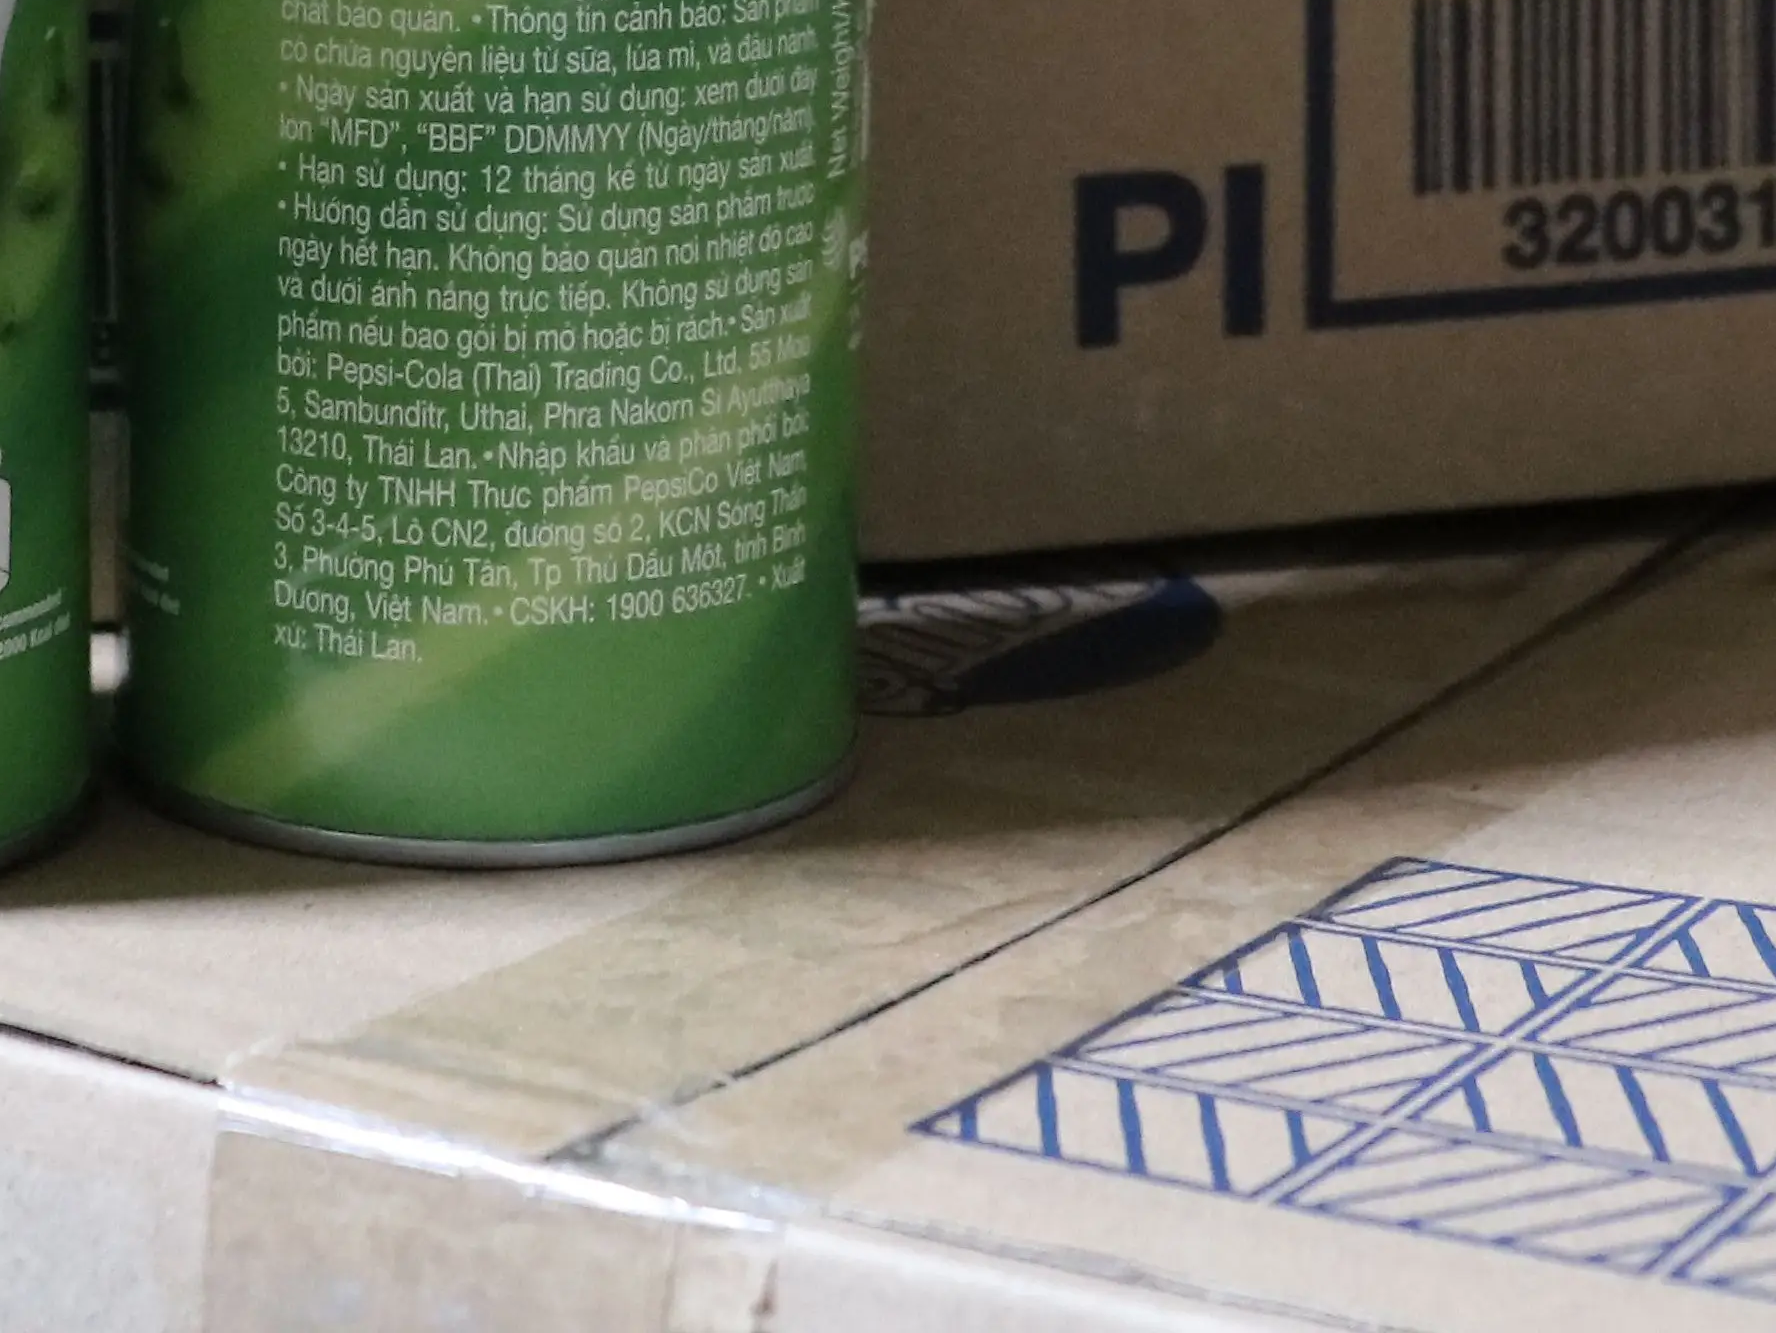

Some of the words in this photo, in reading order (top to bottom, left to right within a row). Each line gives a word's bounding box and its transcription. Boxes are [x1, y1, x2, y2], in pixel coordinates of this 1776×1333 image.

[1072, 164, 1268, 349] PI
[327, 358, 463, 393] Pepsi-Cola
[473, 359, 542, 396] (Thai)
[553, 359, 641, 397] Trading
[649, 354, 695, 388] Co.,
